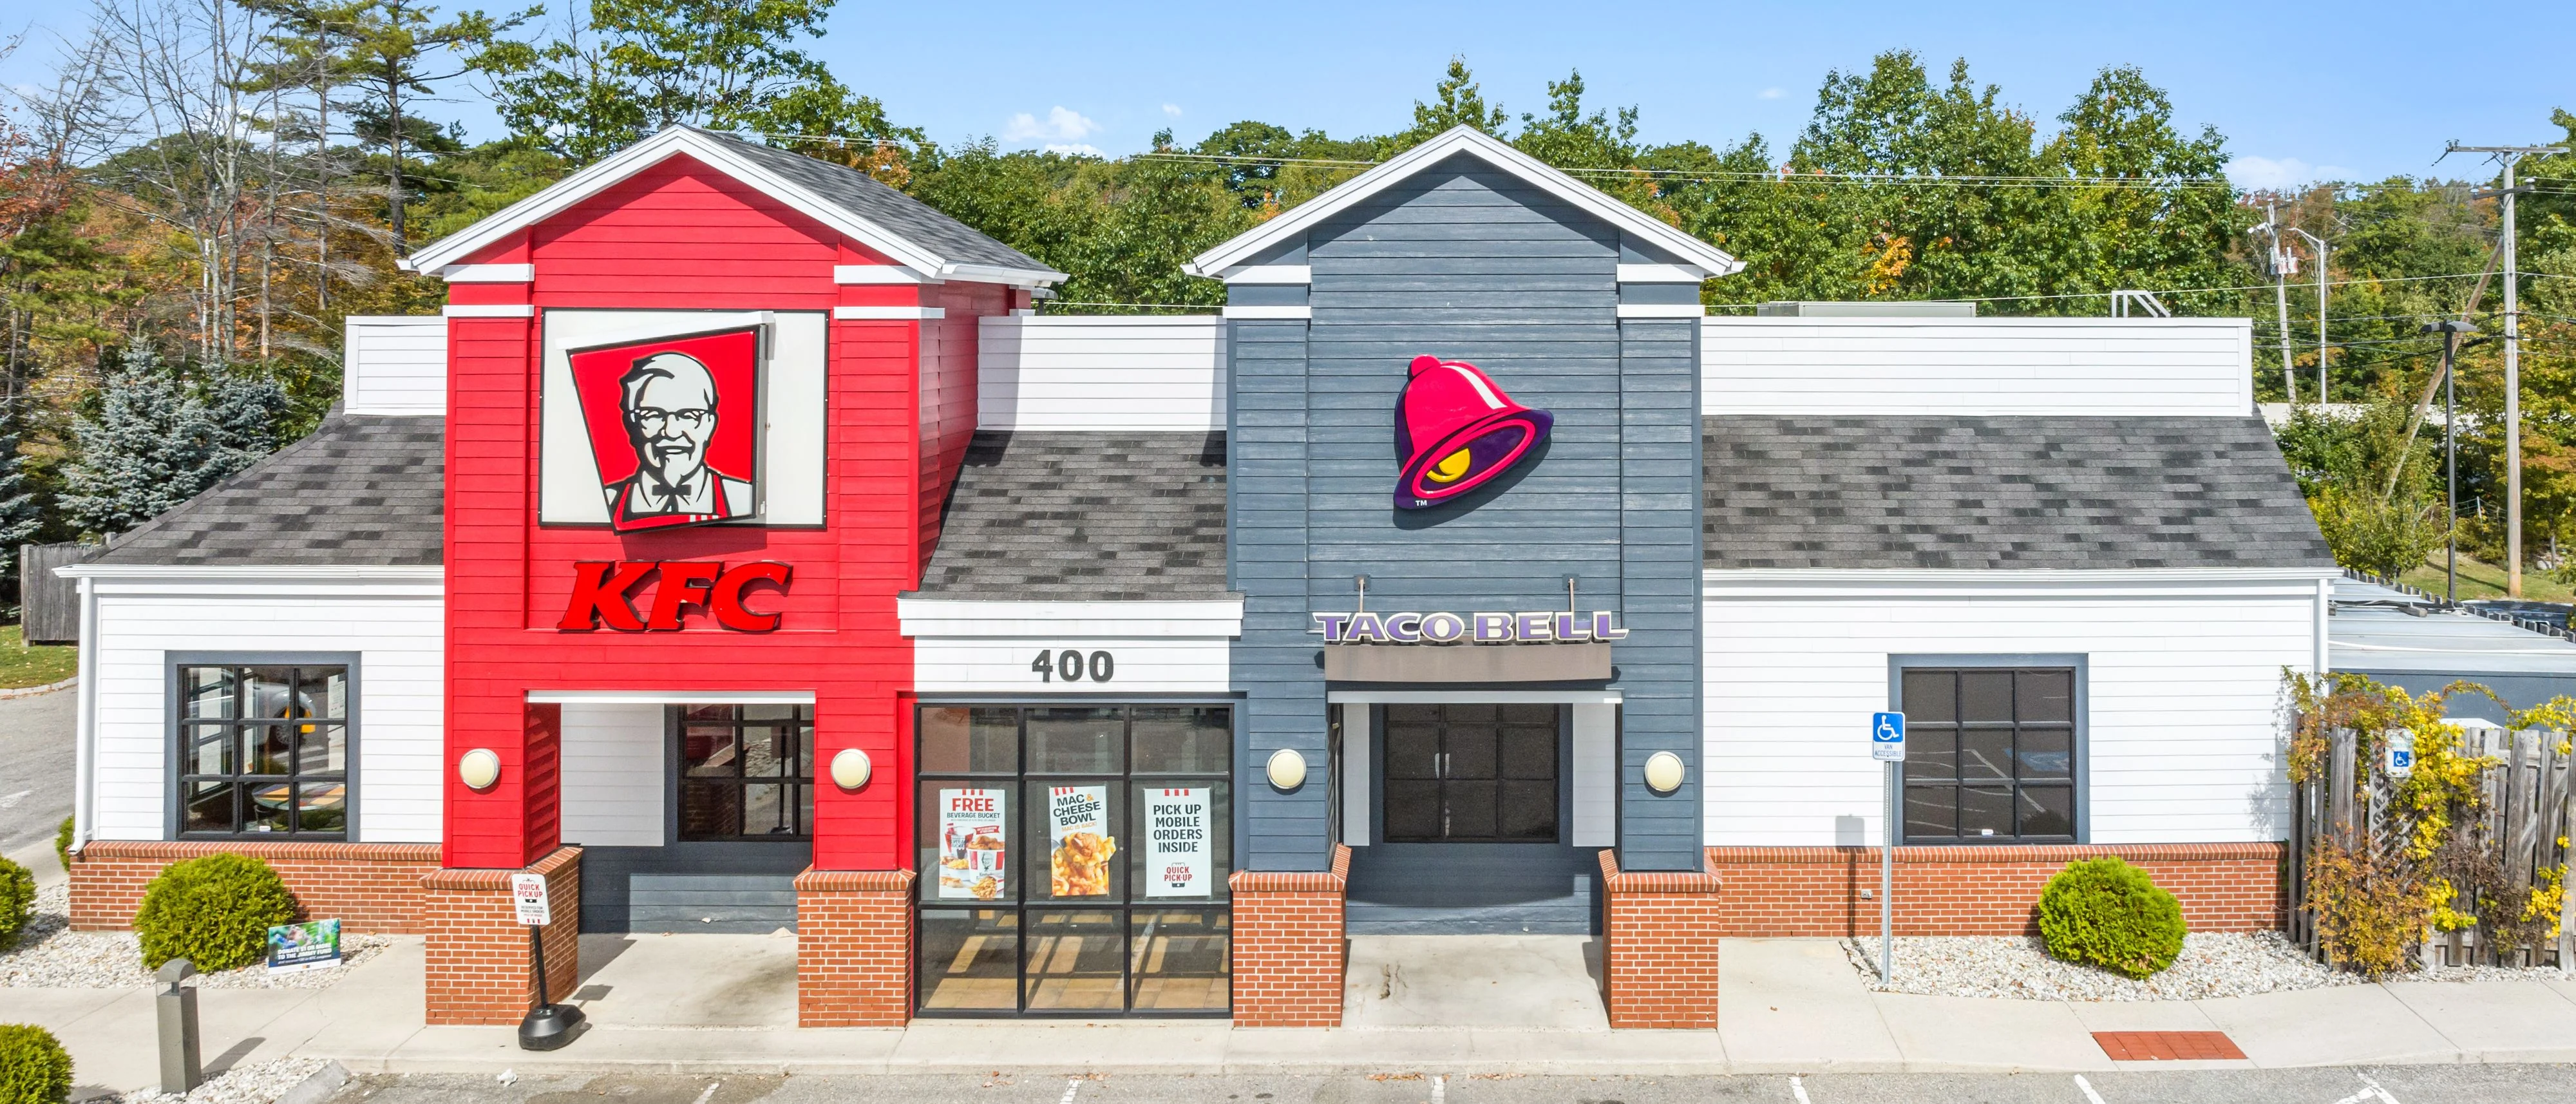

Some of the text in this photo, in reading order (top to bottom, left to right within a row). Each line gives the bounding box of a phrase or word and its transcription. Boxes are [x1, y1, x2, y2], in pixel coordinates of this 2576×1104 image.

[556, 560, 793, 633] KFC
[1312, 611, 1629, 642] TACO BELL
[1032, 649, 1114, 683] 400
[952, 798, 994, 812] FREE
[1056, 794, 1085, 807] MAC
[1054, 801, 1101, 817] CHEESE
[1153, 804, 1202, 815] PICK UP
[1060, 813, 1096, 826] BOWL
[1155, 817, 1200, 828] MOBILE
[1153, 829, 1203, 840] ORDERS
[1159, 842, 1198, 853] INSIDE
